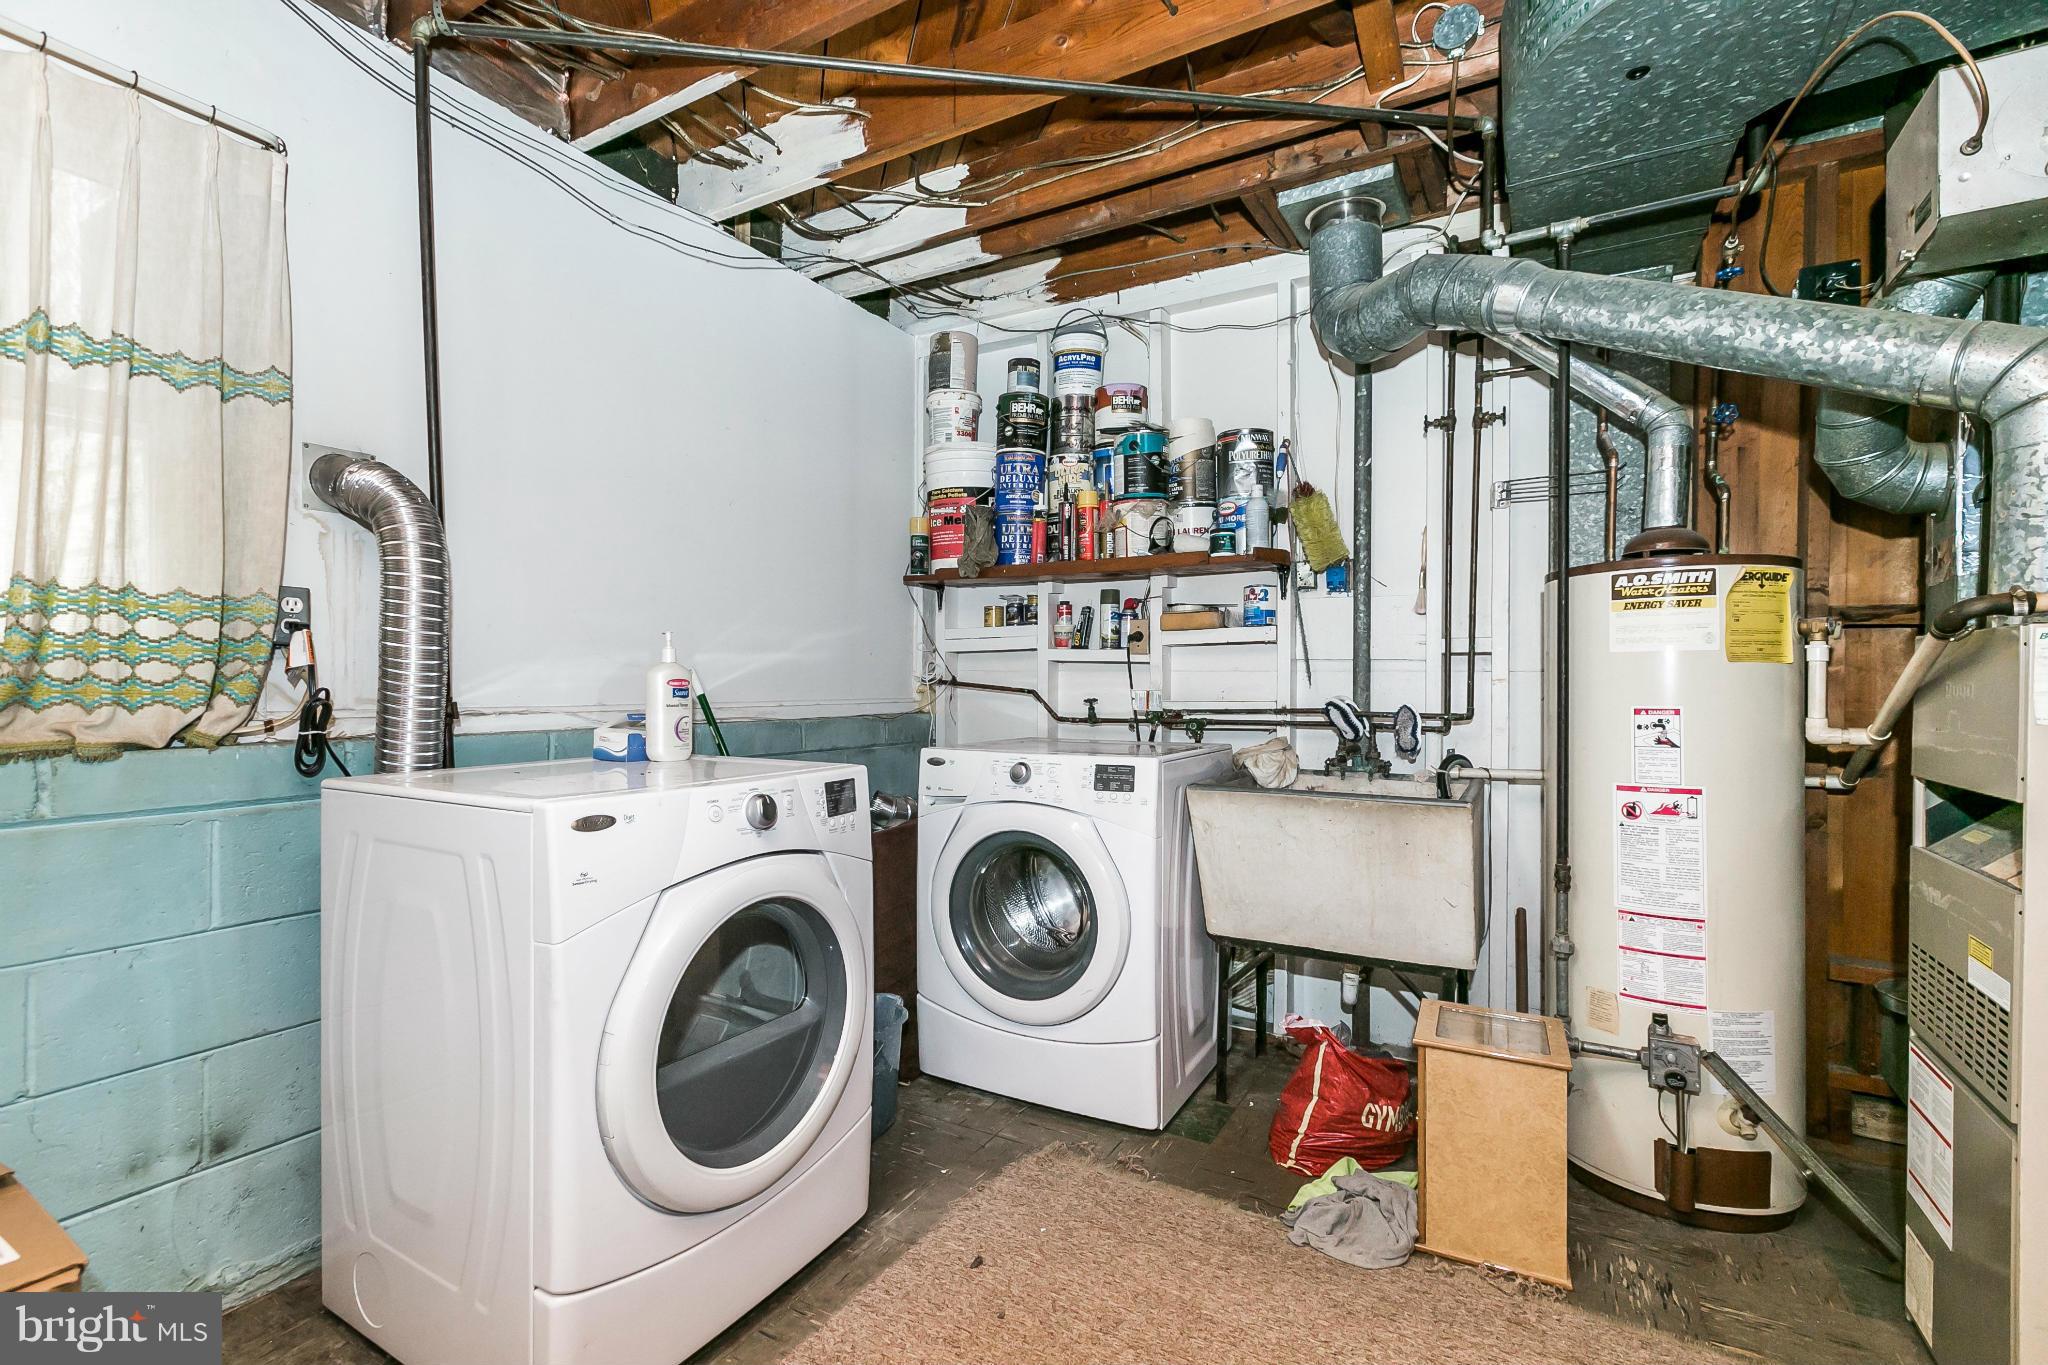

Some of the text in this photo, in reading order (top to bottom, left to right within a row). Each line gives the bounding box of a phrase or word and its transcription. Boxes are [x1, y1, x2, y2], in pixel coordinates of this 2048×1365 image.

[1112, 396, 1134, 405] BEHR
[1011, 402, 1036, 414] BEHR
[1228, 450, 1274, 462] POLYURETHAN
[1000, 463, 1040, 475] ULTRA
[1000, 474, 1040, 483] DELUXE
[930, 515, 966, 528] Ice Mel
[1001, 523, 1032, 535] ULTR
[1001, 534, 1032, 543] DELU
[1741, 571, 1790, 582] ERGYGUIDE
[1620, 584, 1709, 597] Water Heaters
[1623, 599, 1702, 611] ENERGY SAVER
[674, 688, 689, 697] Suave
[1361, 1102, 1405, 1132] GYM
